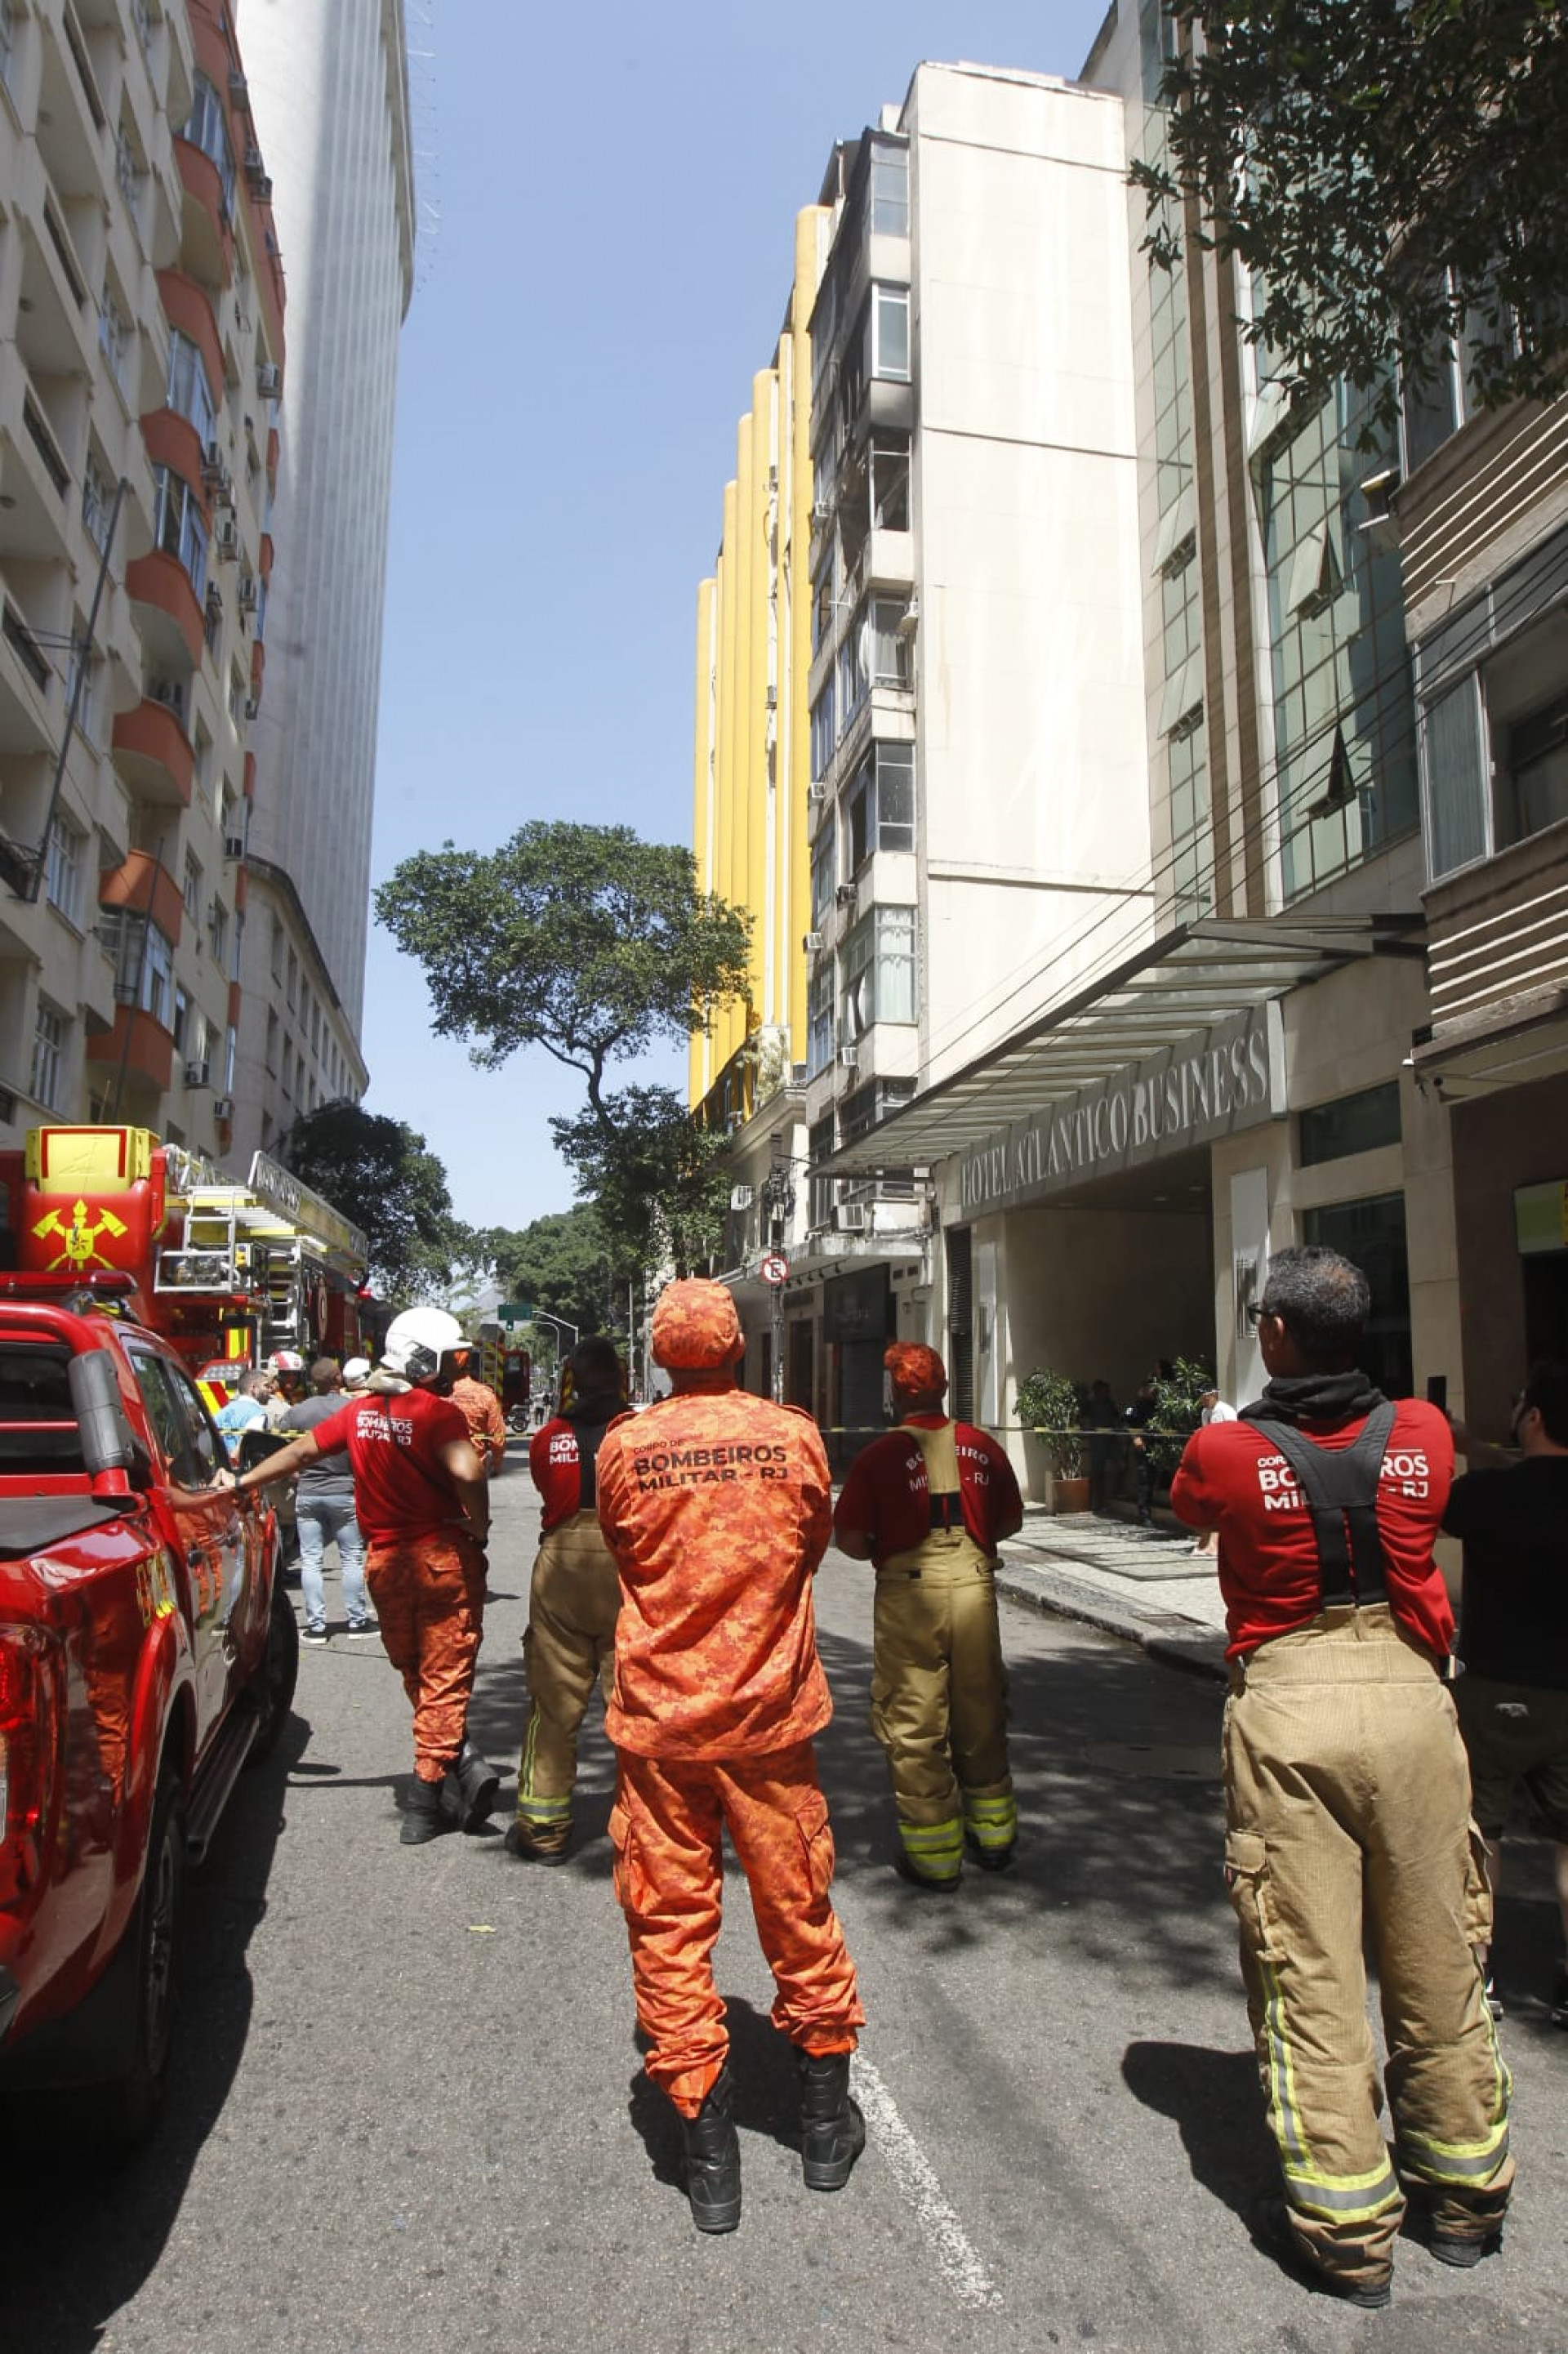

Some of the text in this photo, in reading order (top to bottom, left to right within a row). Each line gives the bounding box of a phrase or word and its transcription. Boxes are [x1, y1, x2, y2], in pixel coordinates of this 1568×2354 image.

[962, 1029, 1267, 1207] HOTEL ATLANTICO BUSINESS
[634, 1439, 684, 1455] CORPO DE
[634, 1444, 786, 1476] BOMBEIROS
[638, 1468, 737, 1493] MILITAR
[760, 1466, 788, 1480] RJ
[1402, 1481, 1429, 1497] RJ
